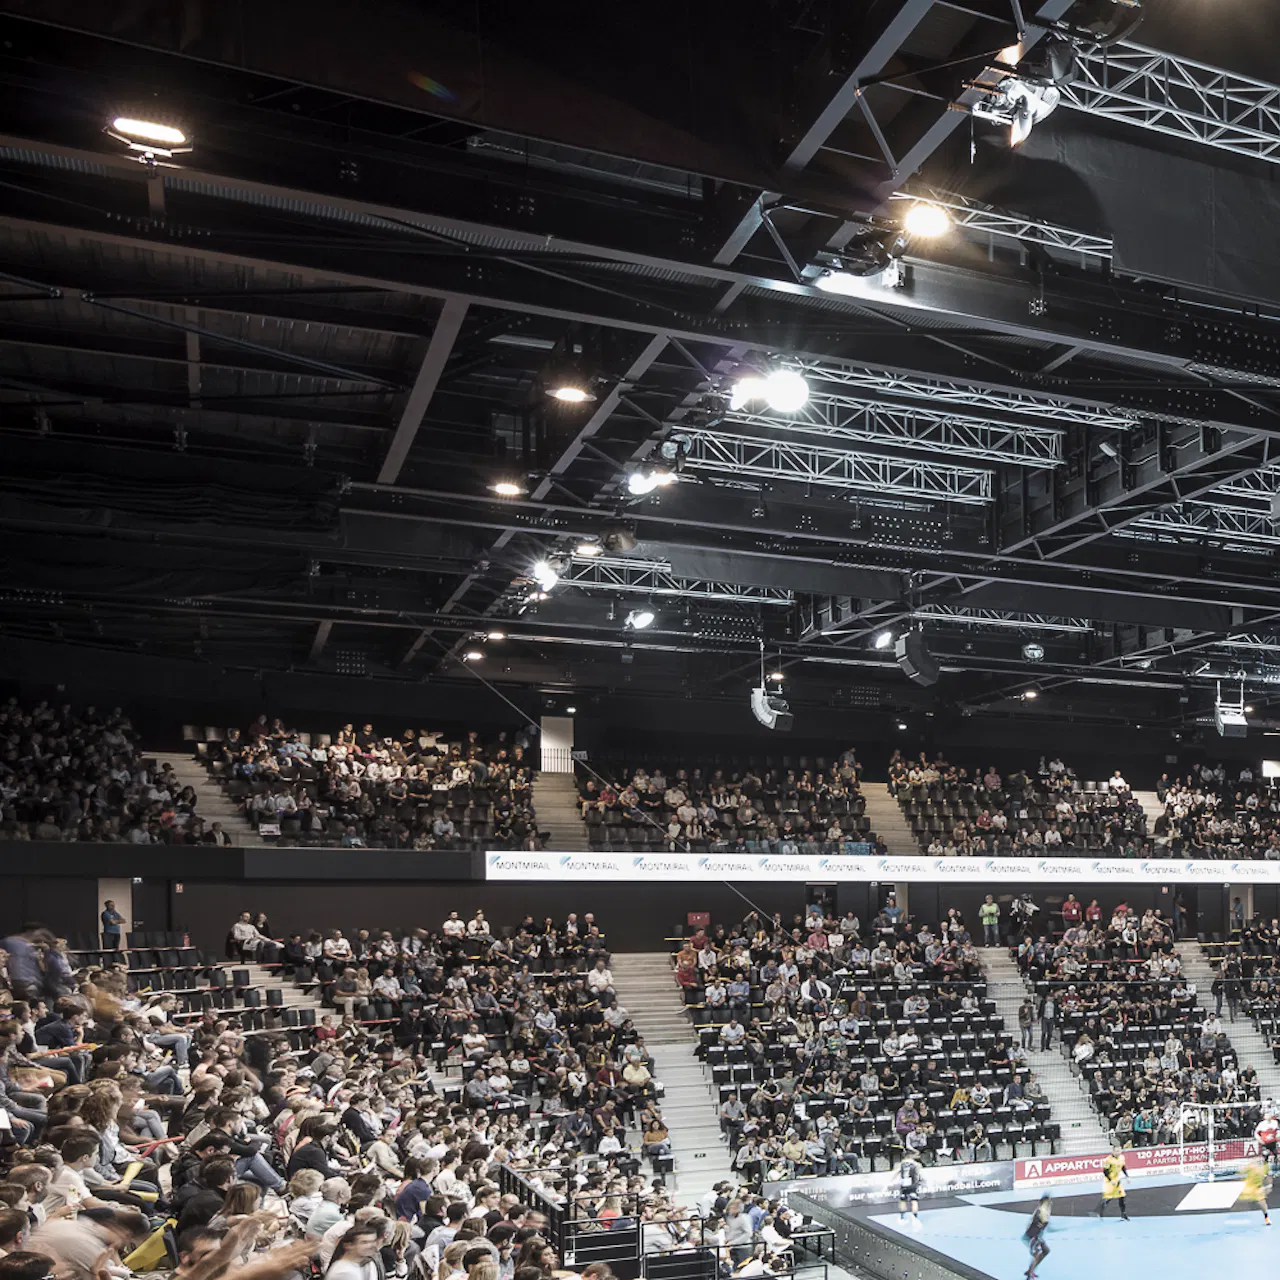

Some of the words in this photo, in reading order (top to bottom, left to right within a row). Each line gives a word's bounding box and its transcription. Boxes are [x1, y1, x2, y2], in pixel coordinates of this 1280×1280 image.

[496, 861, 550, 870] MONTMIRAIL
[1137, 1151, 1152, 1160] 120
[849, 1192, 865, 1201] sur
